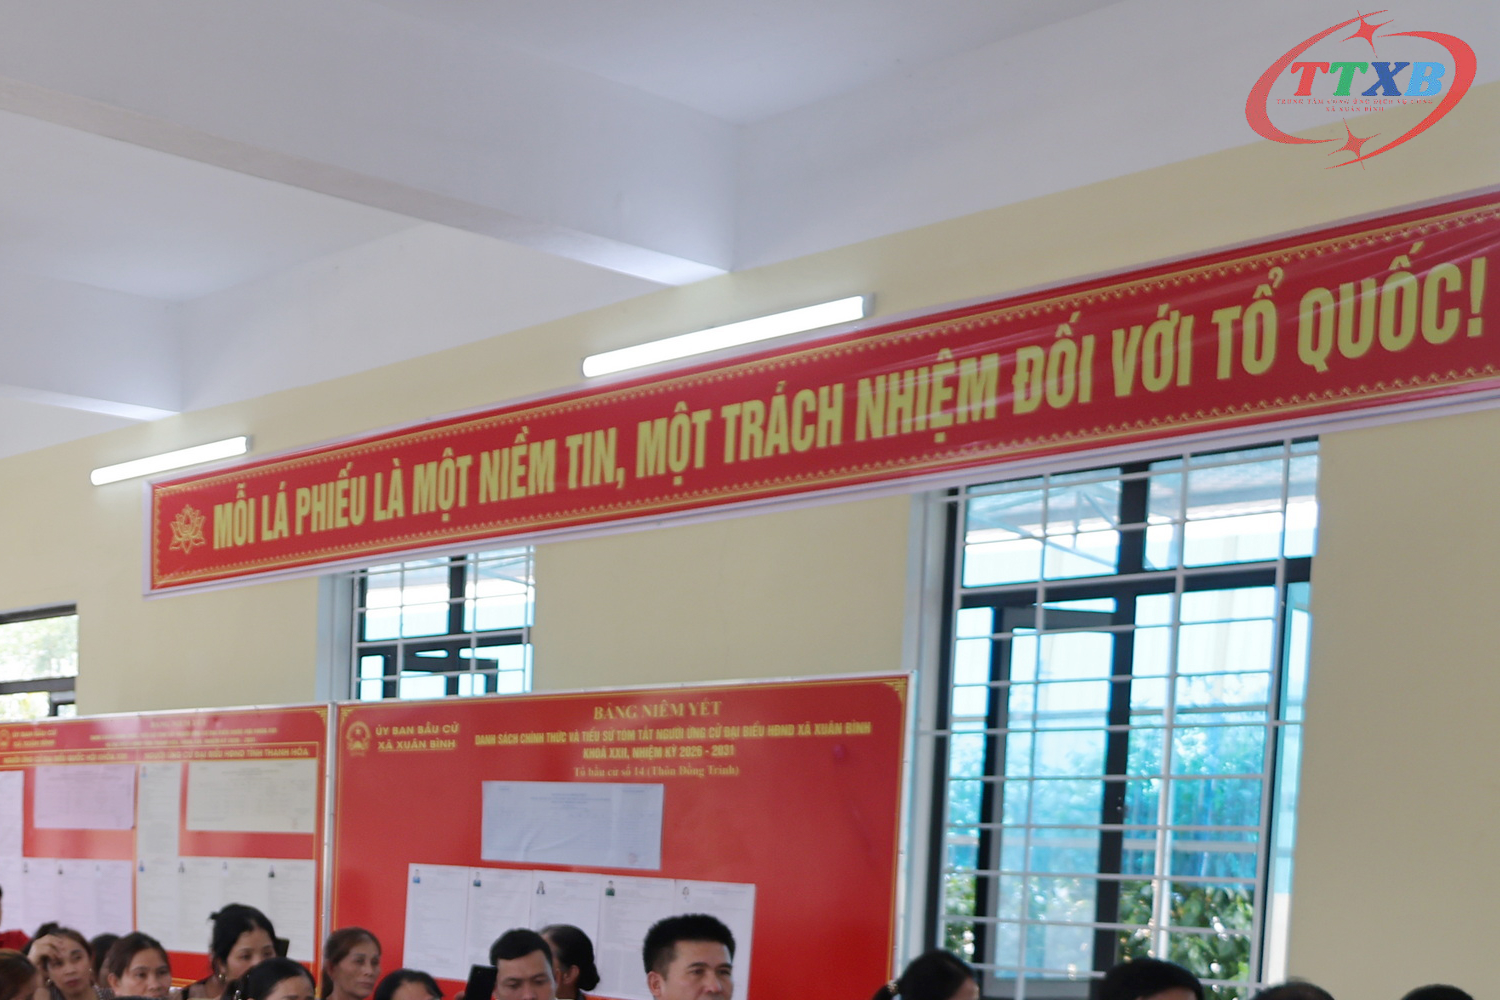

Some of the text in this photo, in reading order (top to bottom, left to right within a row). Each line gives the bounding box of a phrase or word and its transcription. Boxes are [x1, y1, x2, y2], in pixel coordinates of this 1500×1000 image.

[213, 241, 1488, 549] MỖI LÁ PHIẾU LÀ MỘT NIỀM TIN, MỘT TRÁCH NHIỆM ĐỐI VỚI TỔ QUỐC!
[641, 699, 685, 718] NIÊM
[688, 698, 723, 716] YẾT
[392, 726, 415, 736] BAN
[417, 721, 439, 735] BẦU
[429, 737, 456, 749] BÌNH
